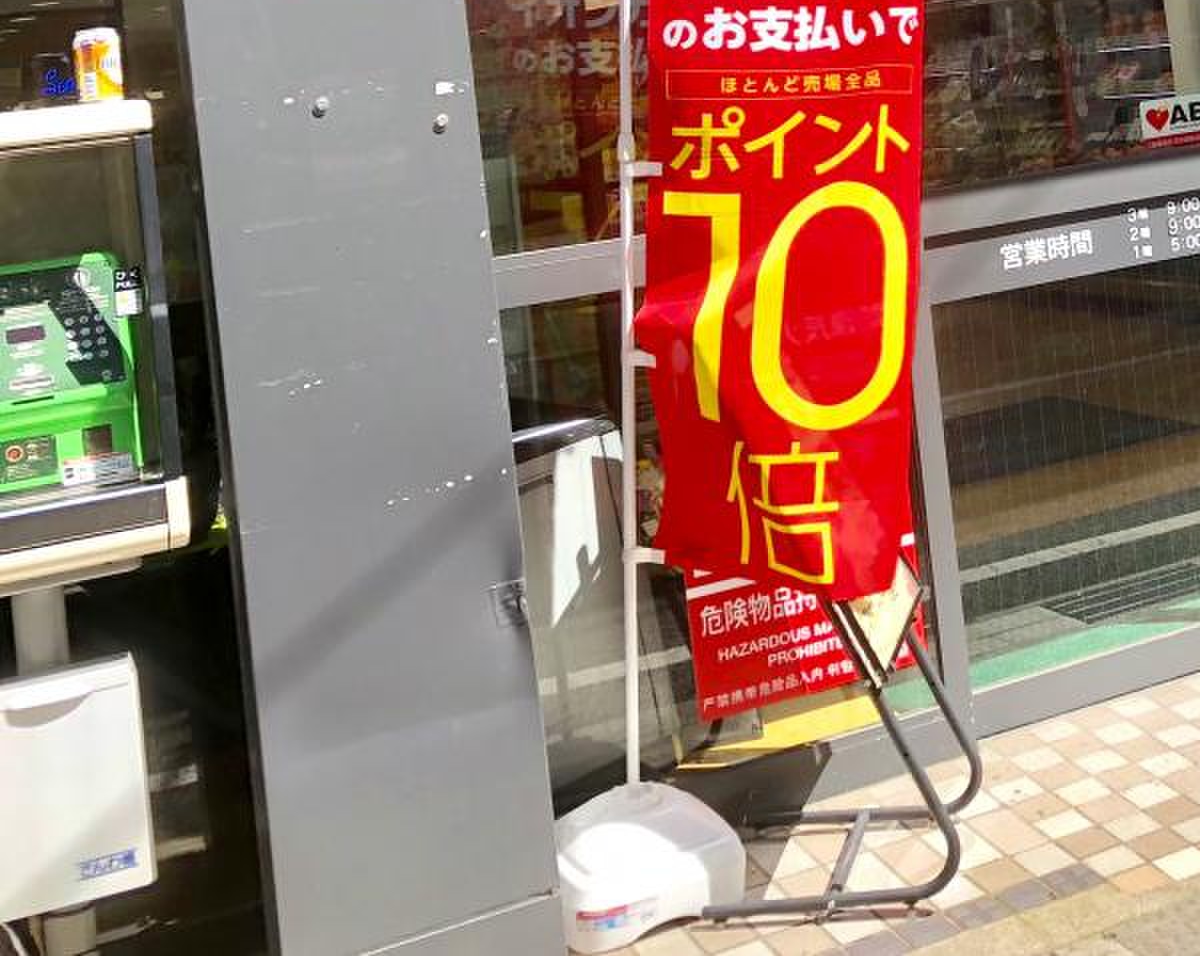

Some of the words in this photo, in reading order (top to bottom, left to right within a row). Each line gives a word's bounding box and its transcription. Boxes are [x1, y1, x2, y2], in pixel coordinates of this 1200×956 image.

[661, 5, 920, 53] のお支払いで
[720, 69, 881, 94] ほとんど売場全品
[669, 104, 911, 180] ポイント
[999, 228, 1094, 271] 営業時間
[663, 181, 909, 431] 10
[726, 440, 840, 585] 倍
[717, 625, 812, 664] HAZARDOUS
